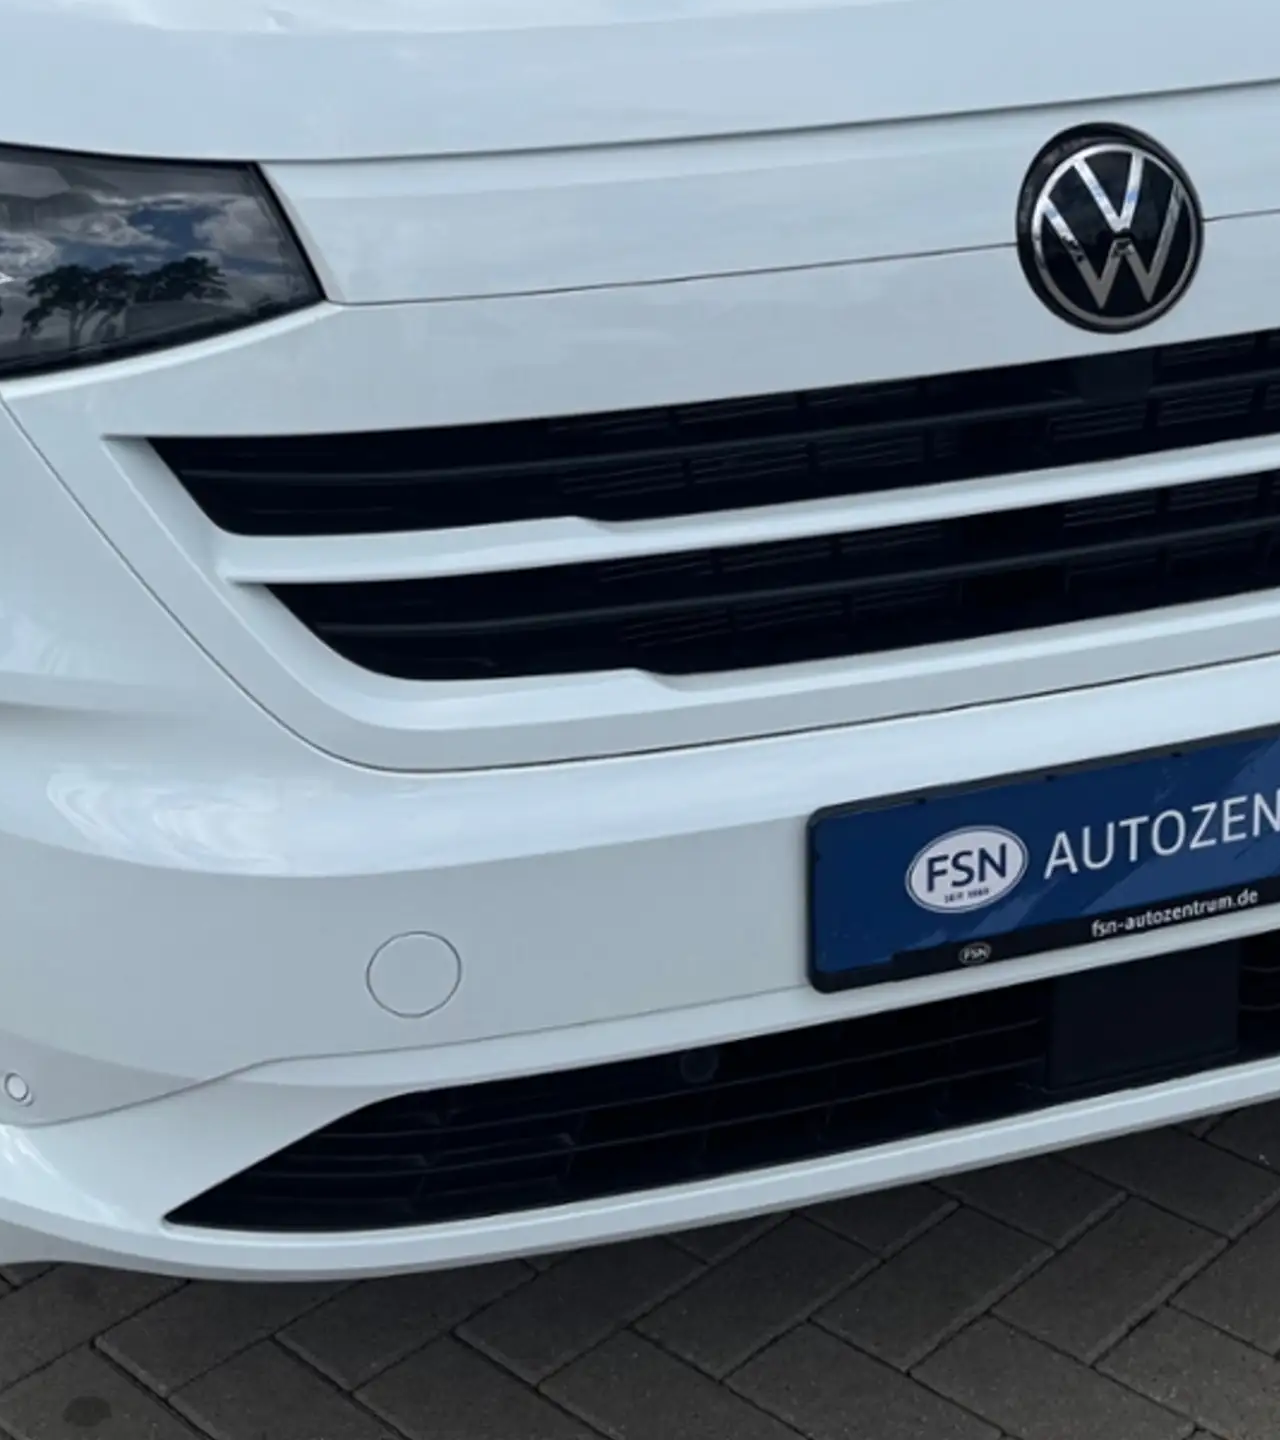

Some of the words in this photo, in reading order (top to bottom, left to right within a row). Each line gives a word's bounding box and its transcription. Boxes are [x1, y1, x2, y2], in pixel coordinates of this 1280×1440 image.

[1035, 148, 1188, 312] VW
[926, 841, 1008, 894] FSN
[1090, 887, 1260, 938] fsn-autozentrum.de
